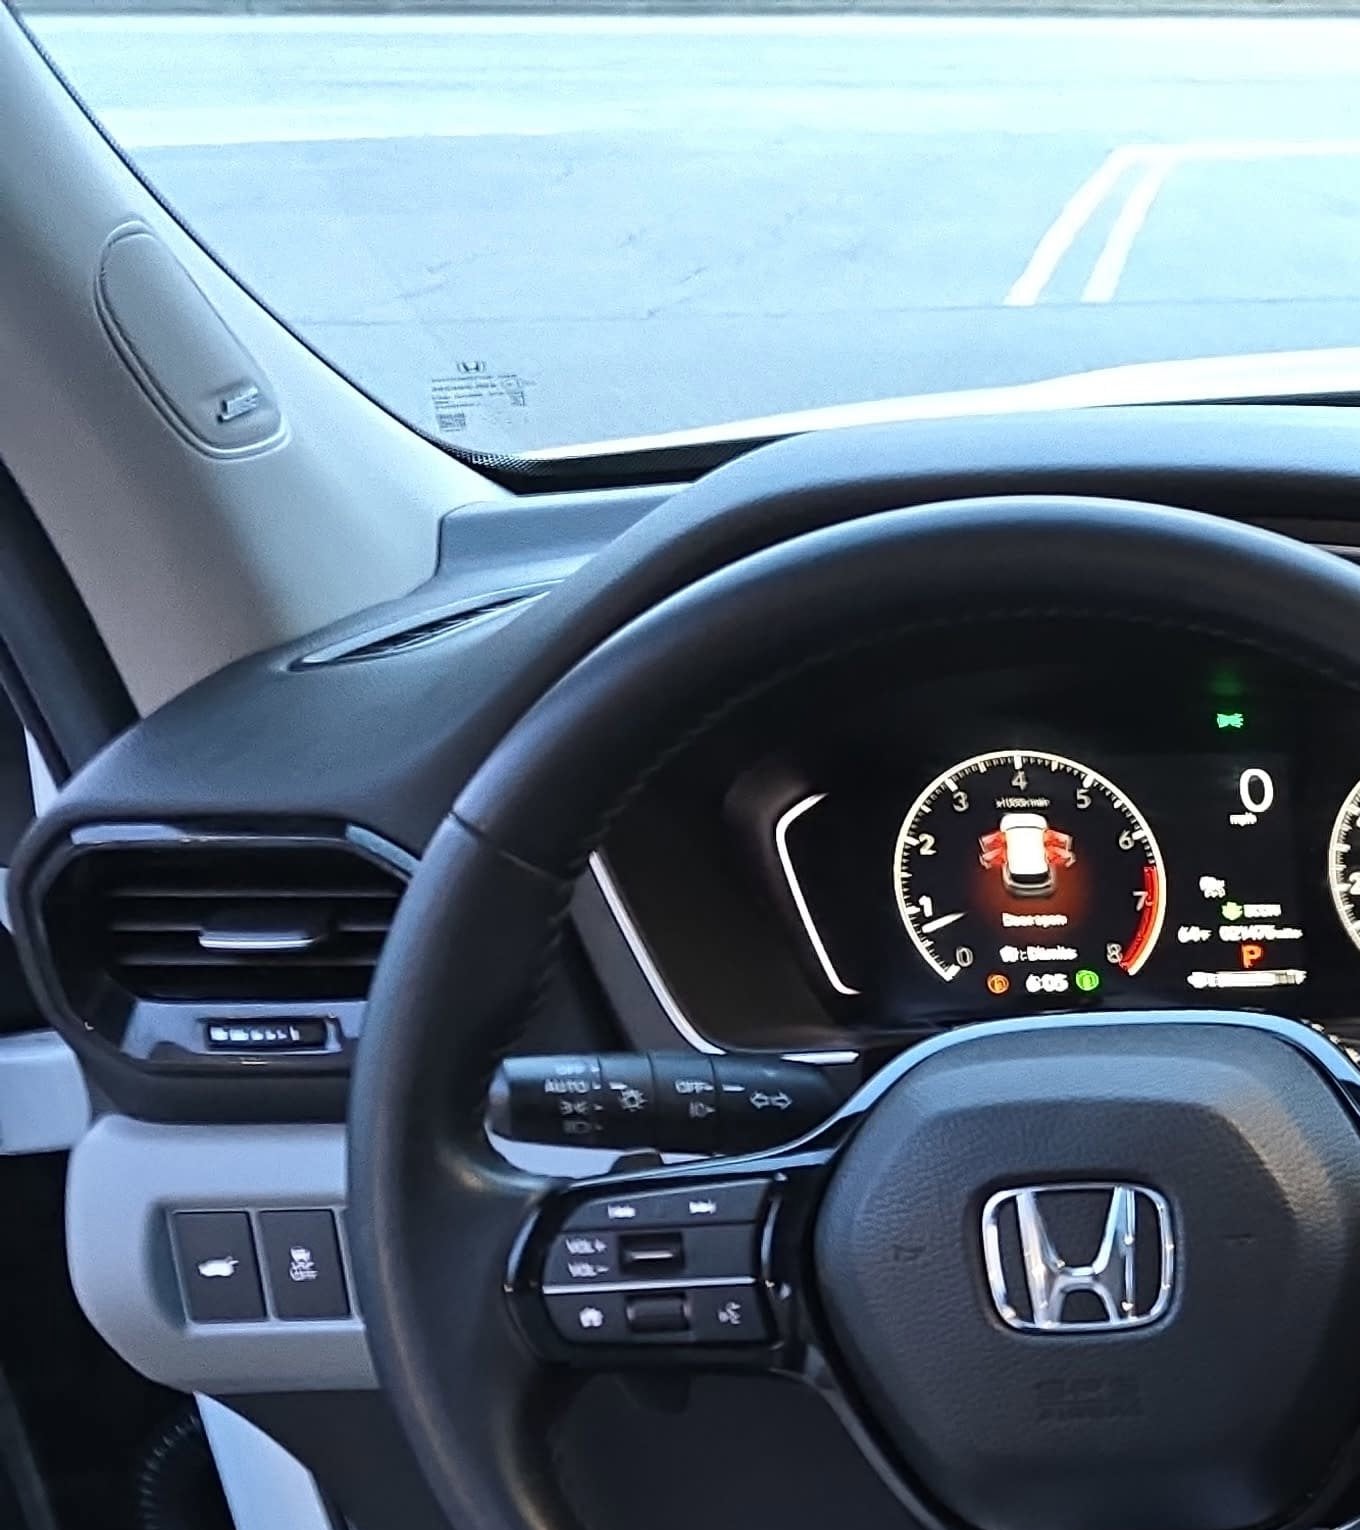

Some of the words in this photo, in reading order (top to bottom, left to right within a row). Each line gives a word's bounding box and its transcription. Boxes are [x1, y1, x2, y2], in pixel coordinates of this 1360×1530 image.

[1012, 771, 1028, 791] 4
[1239, 768, 1274, 813] 0
[953, 792, 969, 812] 3
[1076, 788, 1091, 808] 5
[919, 834, 936, 854] 2
[1119, 830, 1134, 850] 6
[919, 895, 932, 917] 1
[1133, 891, 1149, 911] 7
[956, 947, 973, 968] 0
[1106, 942, 1121, 963] 8
[1242, 945, 1262, 969] P
[1026, 973, 1069, 993] 6:05
[544, 1079, 590, 1094] AUTO
